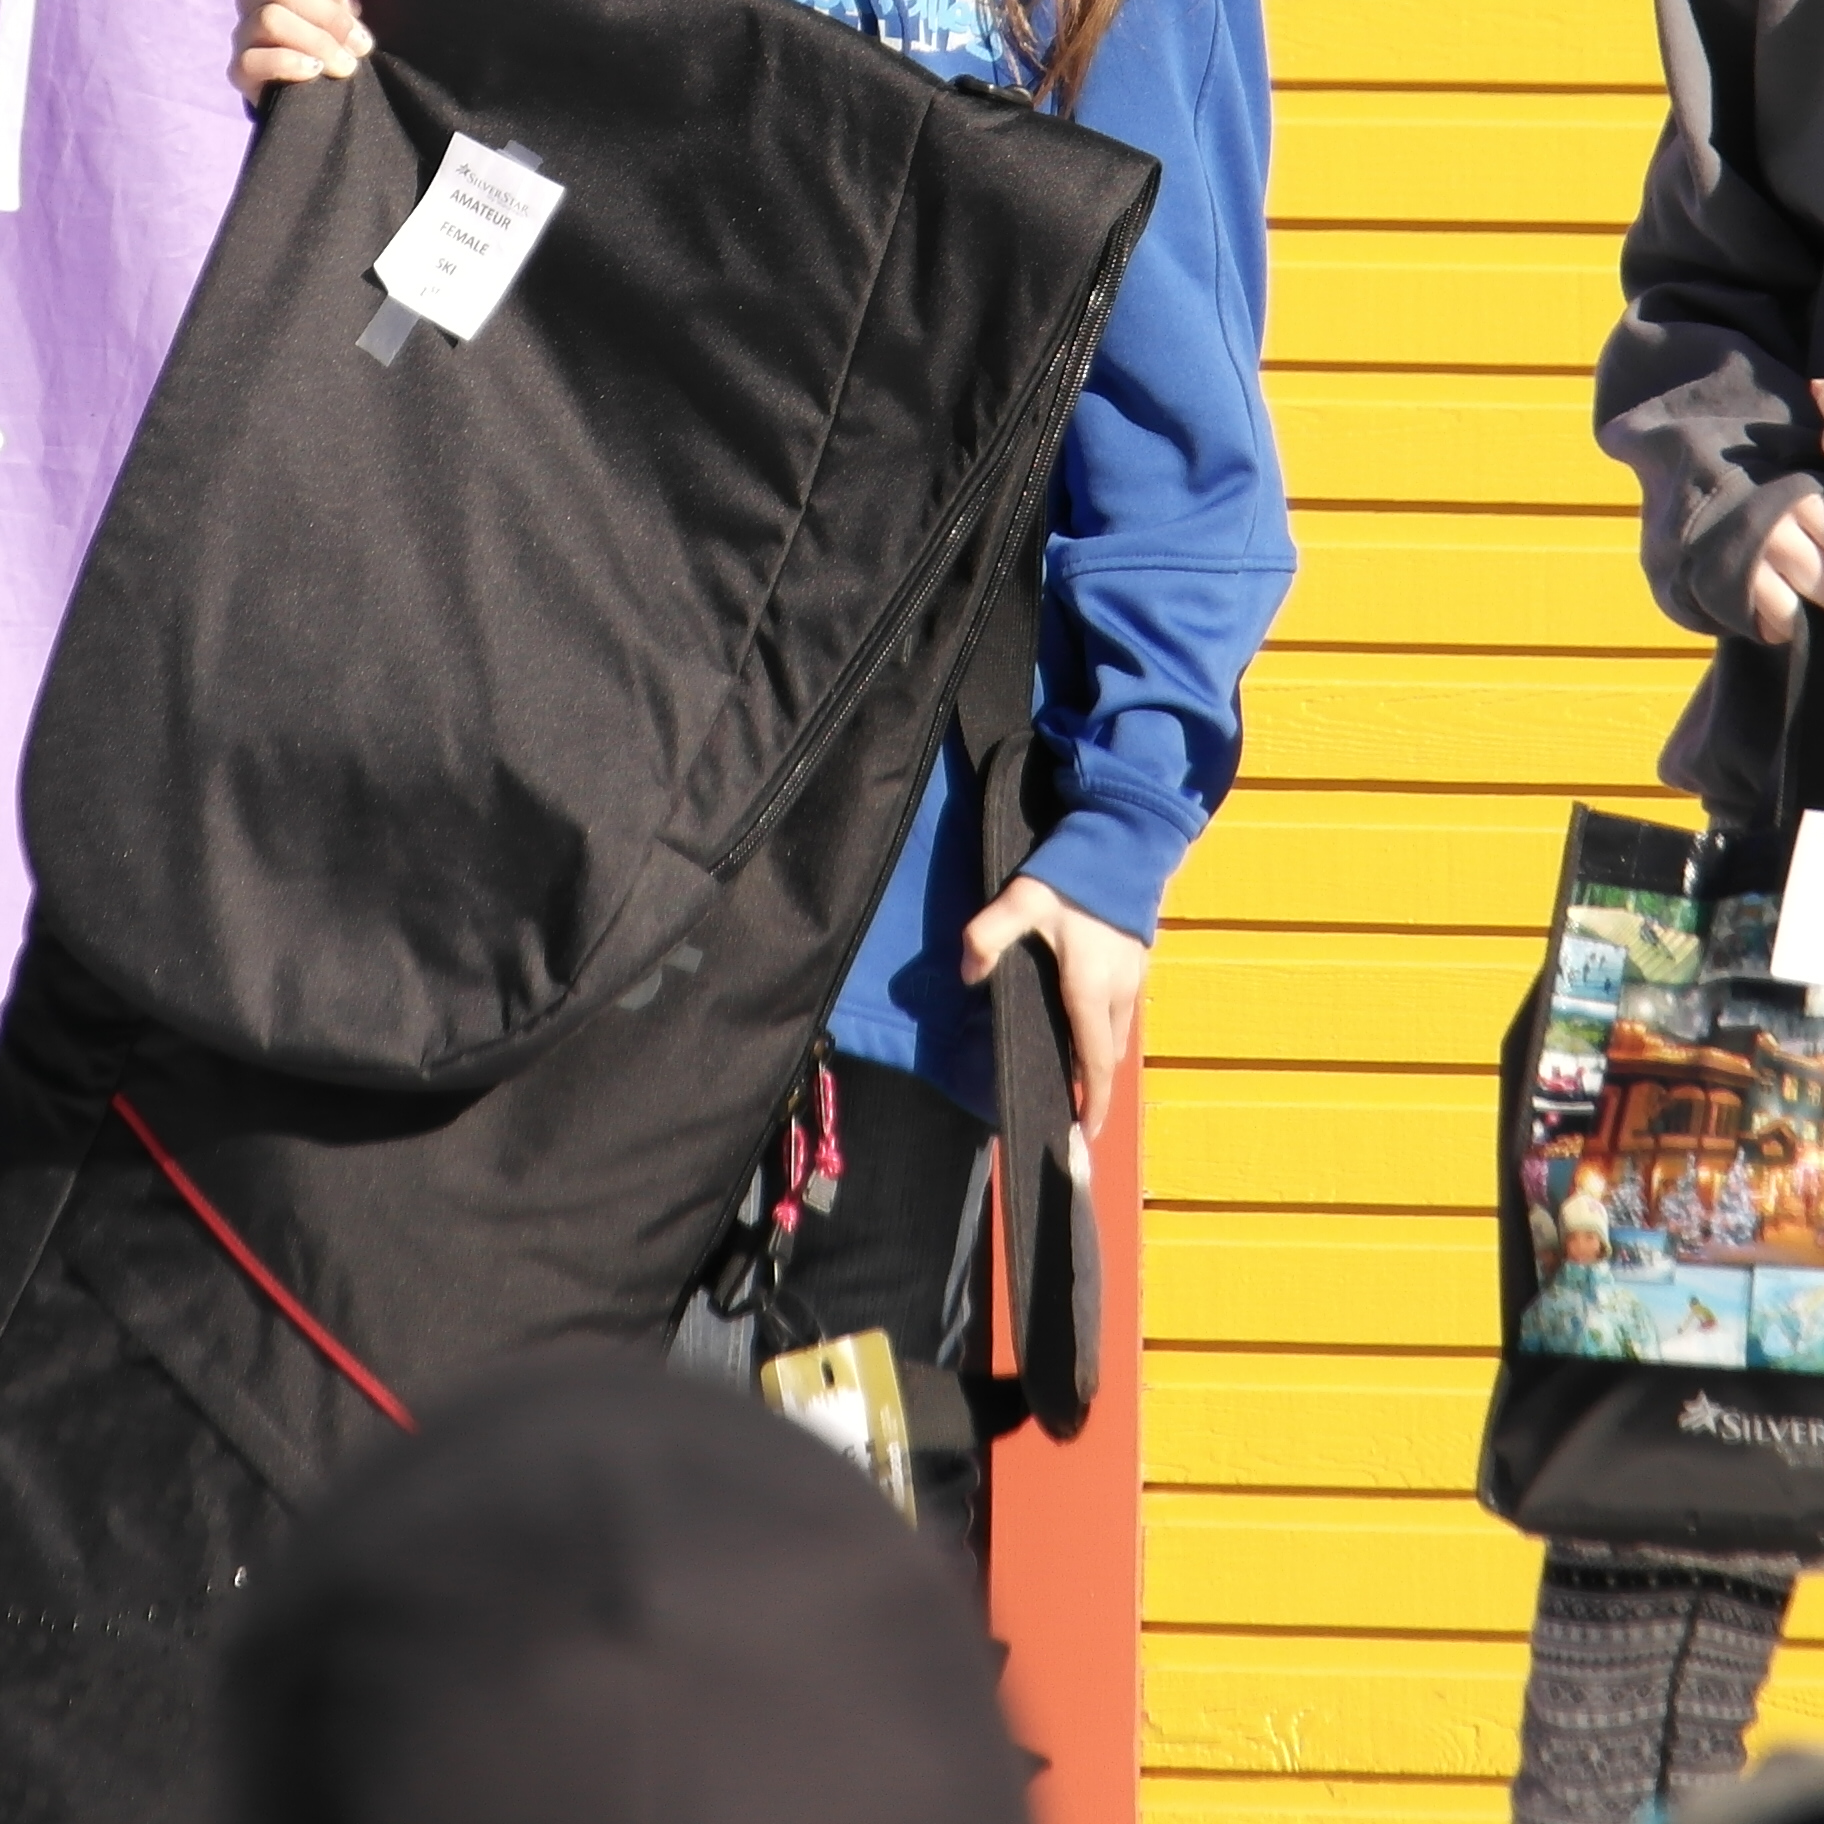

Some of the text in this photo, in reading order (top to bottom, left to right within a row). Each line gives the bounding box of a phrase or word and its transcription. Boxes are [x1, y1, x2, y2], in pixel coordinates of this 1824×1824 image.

[449, 188, 512, 231] AMATEUR
[439, 221, 490, 256] FEMALE
[435, 257, 458, 277] SKI
